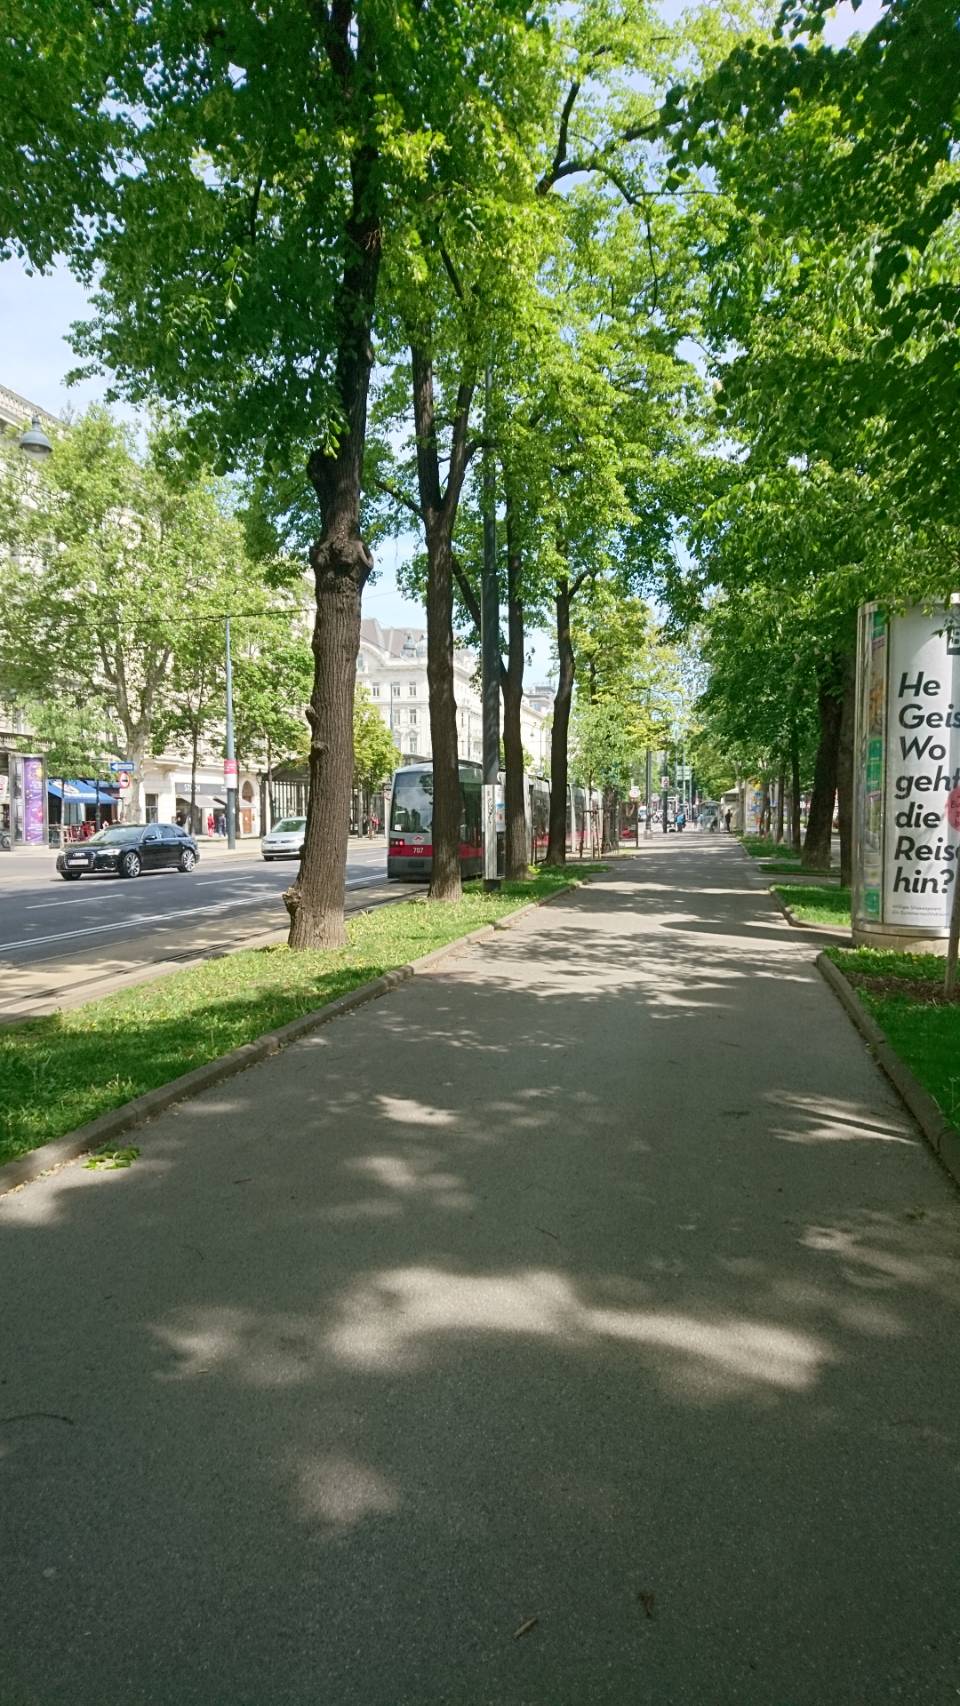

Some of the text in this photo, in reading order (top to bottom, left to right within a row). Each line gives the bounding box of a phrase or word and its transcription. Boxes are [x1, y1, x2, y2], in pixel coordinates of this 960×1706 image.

[898, 671, 941, 698] He
[900, 735, 946, 761] Wo
[895, 765, 960, 800] geht
[895, 801, 941, 828] die
[893, 866, 955, 894] hin?
